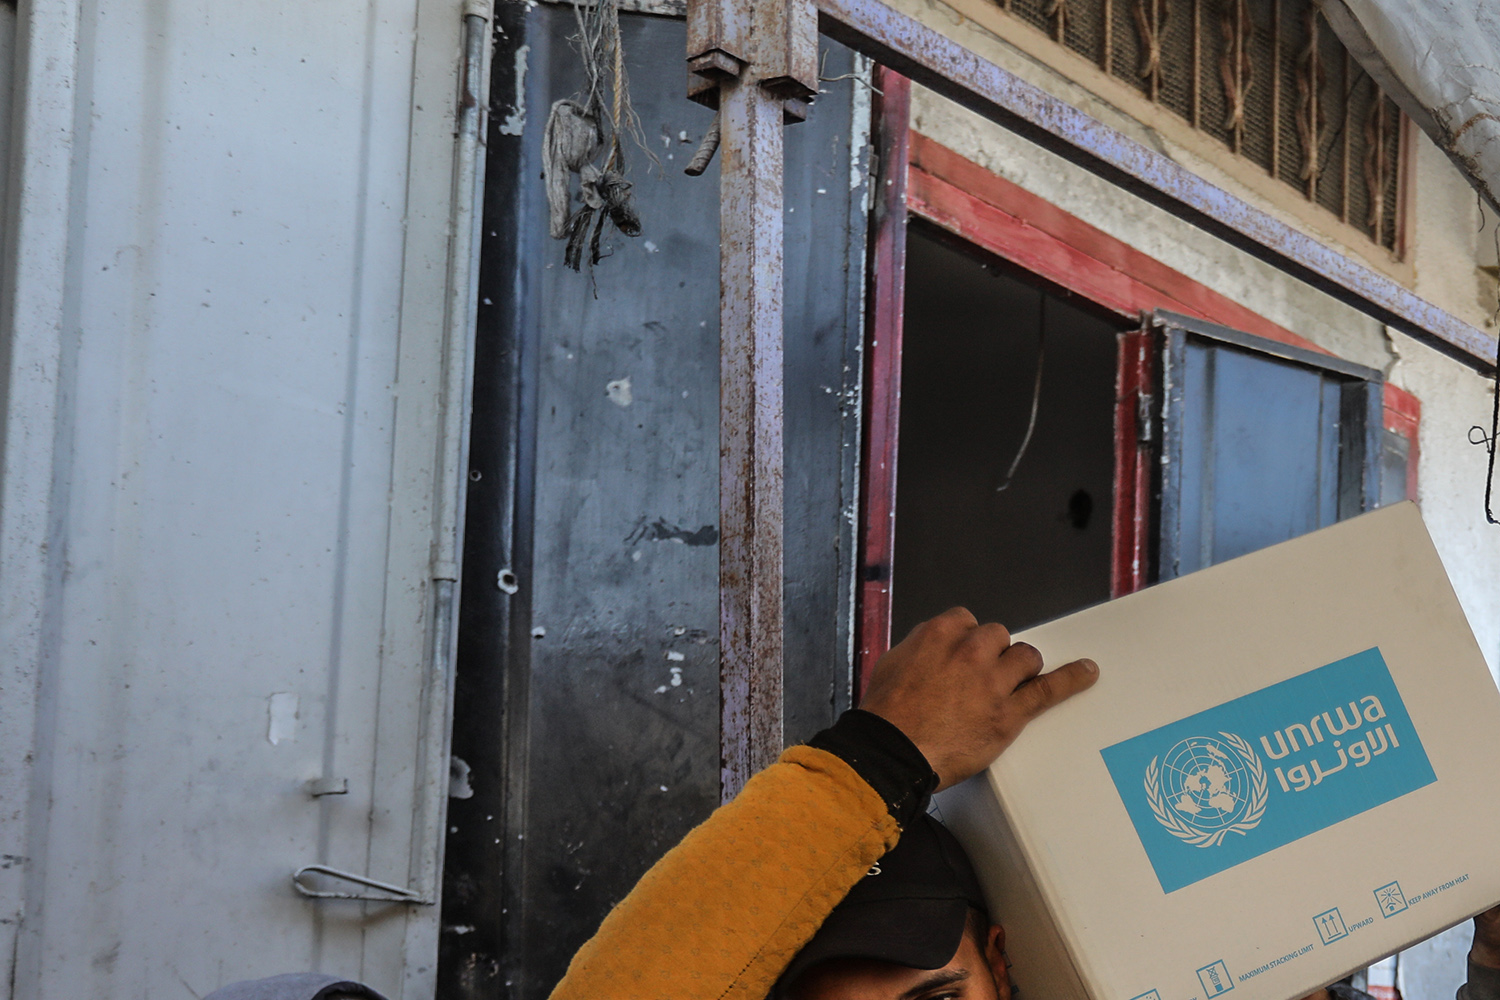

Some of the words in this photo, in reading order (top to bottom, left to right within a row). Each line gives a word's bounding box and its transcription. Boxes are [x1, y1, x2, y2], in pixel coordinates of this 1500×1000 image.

[1259, 695, 1387, 760] unrwa
[1408, 895, 1422, 906] KEEP
[1422, 888, 1439, 900] AWAY
[1438, 881, 1456, 892] FROM
[1454, 873, 1470, 886] HEAT
[1348, 917, 1374, 933] UPWARD
[1238, 964, 1270, 983] MAXIMUM
[1269, 951, 1299, 969] STACKING
[1298, 943, 1315, 956] LIMIT
